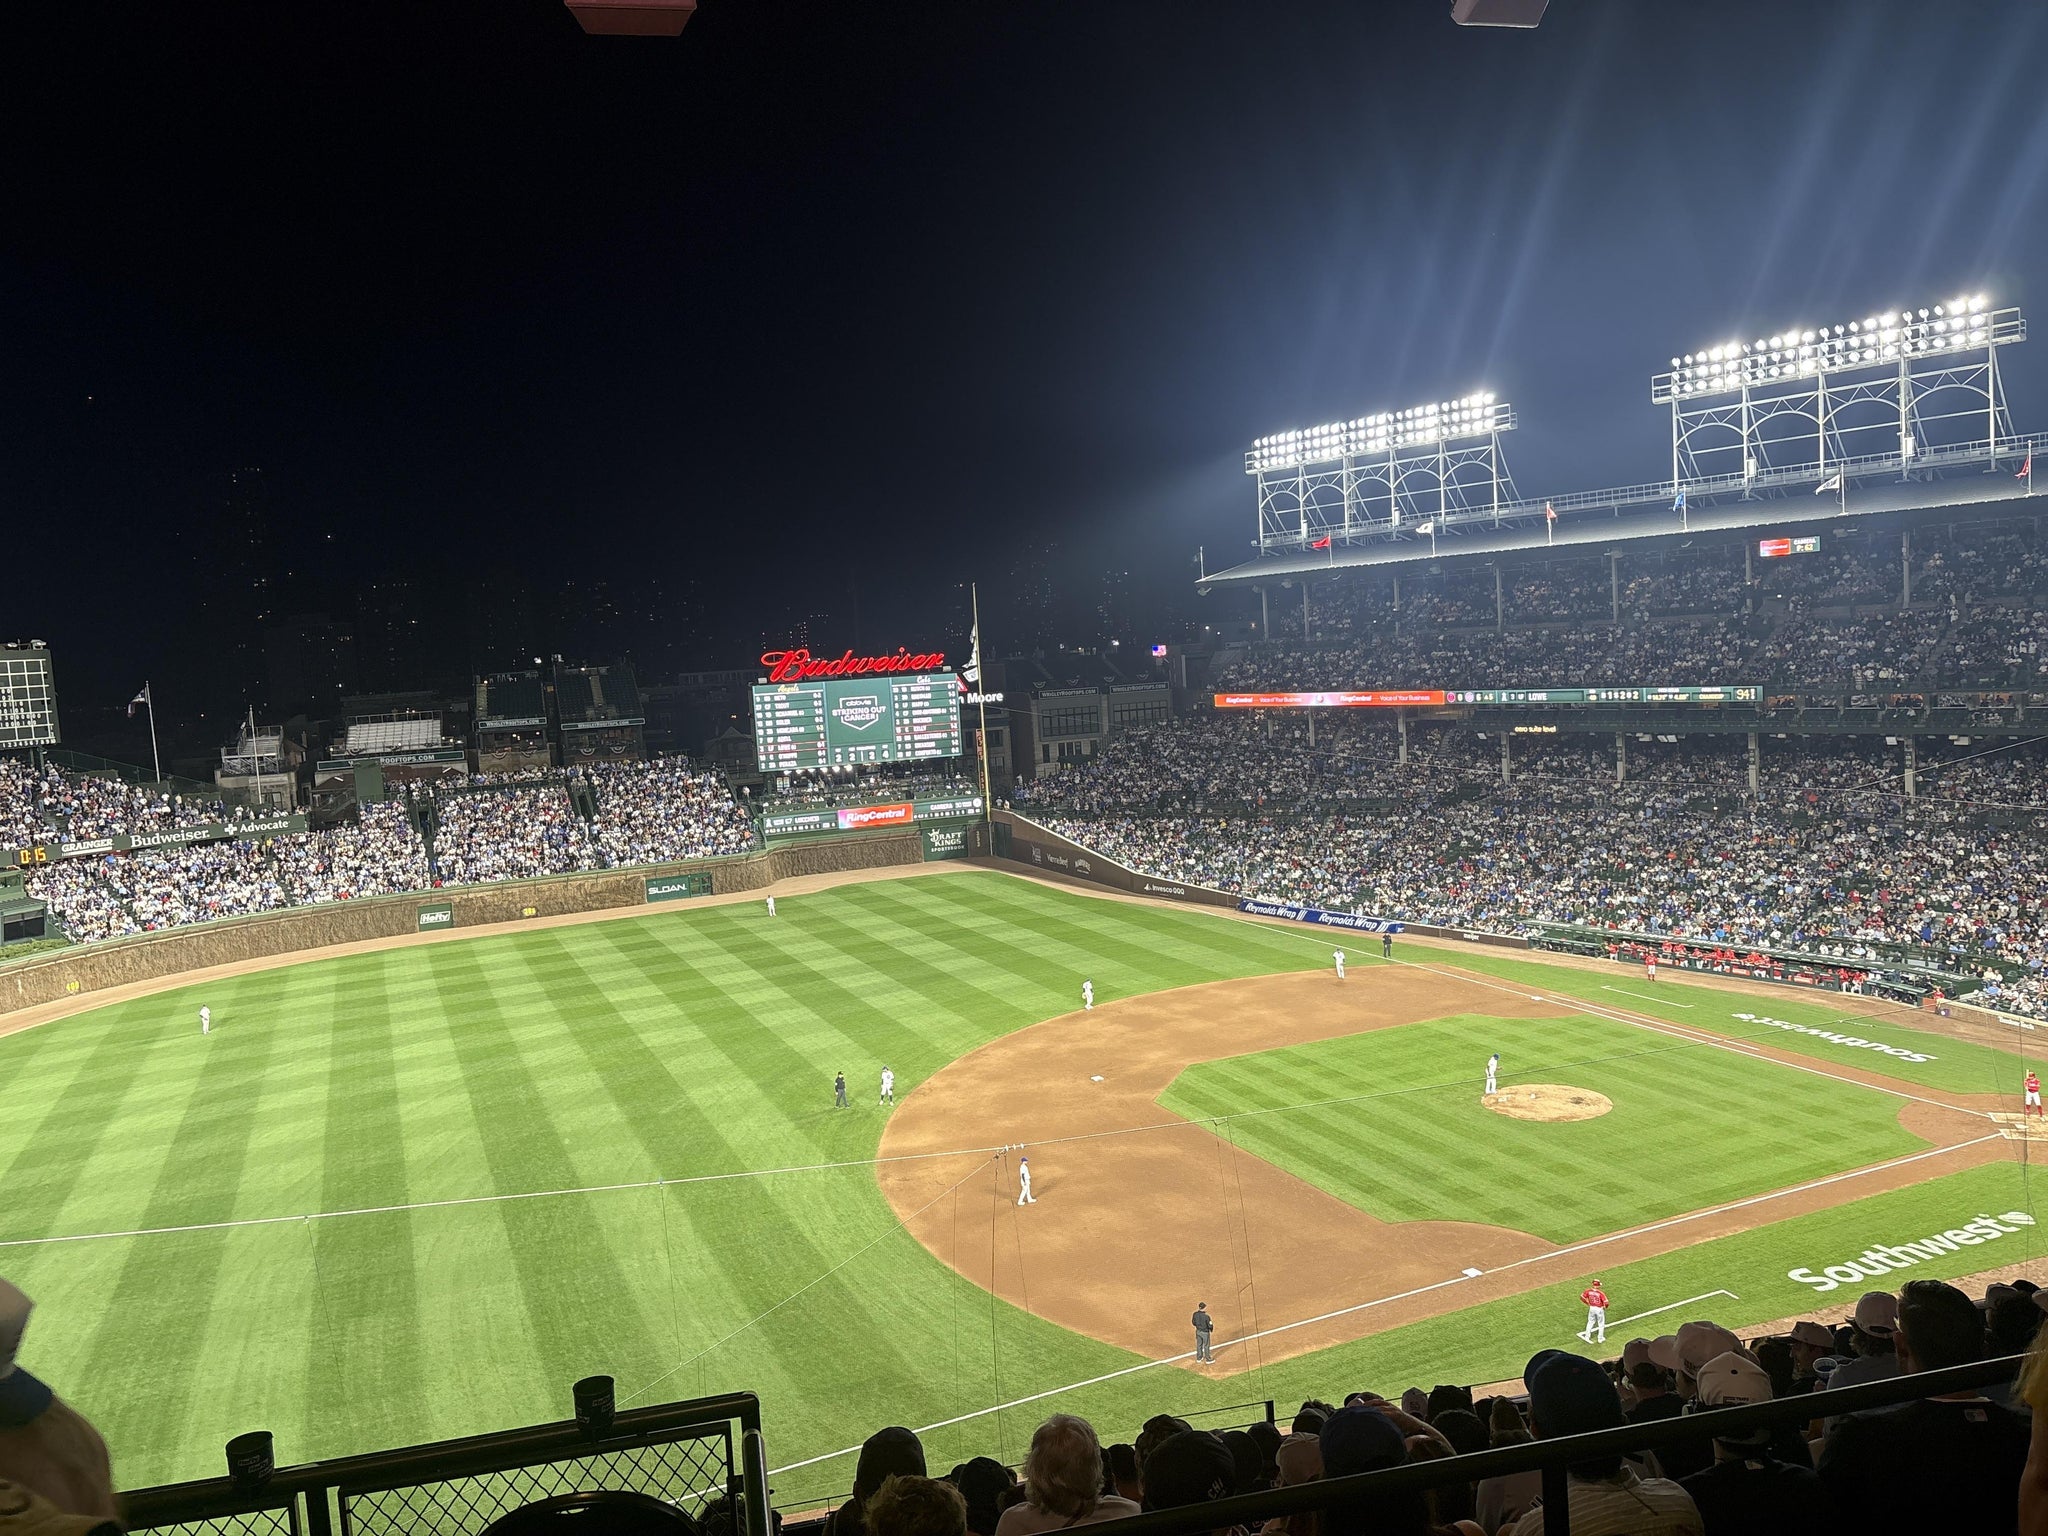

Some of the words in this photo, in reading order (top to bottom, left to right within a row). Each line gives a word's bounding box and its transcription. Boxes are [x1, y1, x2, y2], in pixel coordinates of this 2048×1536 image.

[761, 646, 945, 682] Budweiser
[917, 675, 931, 684] Cubs
[967, 693, 1004, 704] Moore
[1340, 695, 1372, 703] RingCentral
[1528, 692, 1548, 701] LOWE
[1736, 689, 1749, 700] 94
[832, 707, 869, 716] STRIKING
[844, 713, 875, 721] CANCER
[835, 754, 842, 762] 2
[849, 753, 856, 761] 2
[883, 750, 889, 758] 4
[846, 808, 906, 822] RingCentral
[240, 822, 289, 833] Advocate
[930, 832, 962, 843] DRAFT
[935, 838, 962, 847] KINGS
[61, 838, 113, 852] GRAINGER
[1152, 884, 1173, 893] Invesco
[1245, 902, 1277, 916] Reynolds
[1277, 907, 1296, 919] Wrap
[423, 912, 449, 922] Hefty
[1319, 912, 1355, 927] Reynolds
[1355, 918, 1377, 930] Wrap
[1752, 1016, 1939, 1062] Southwest
[1787, 1213, 2022, 1292] Southwest
